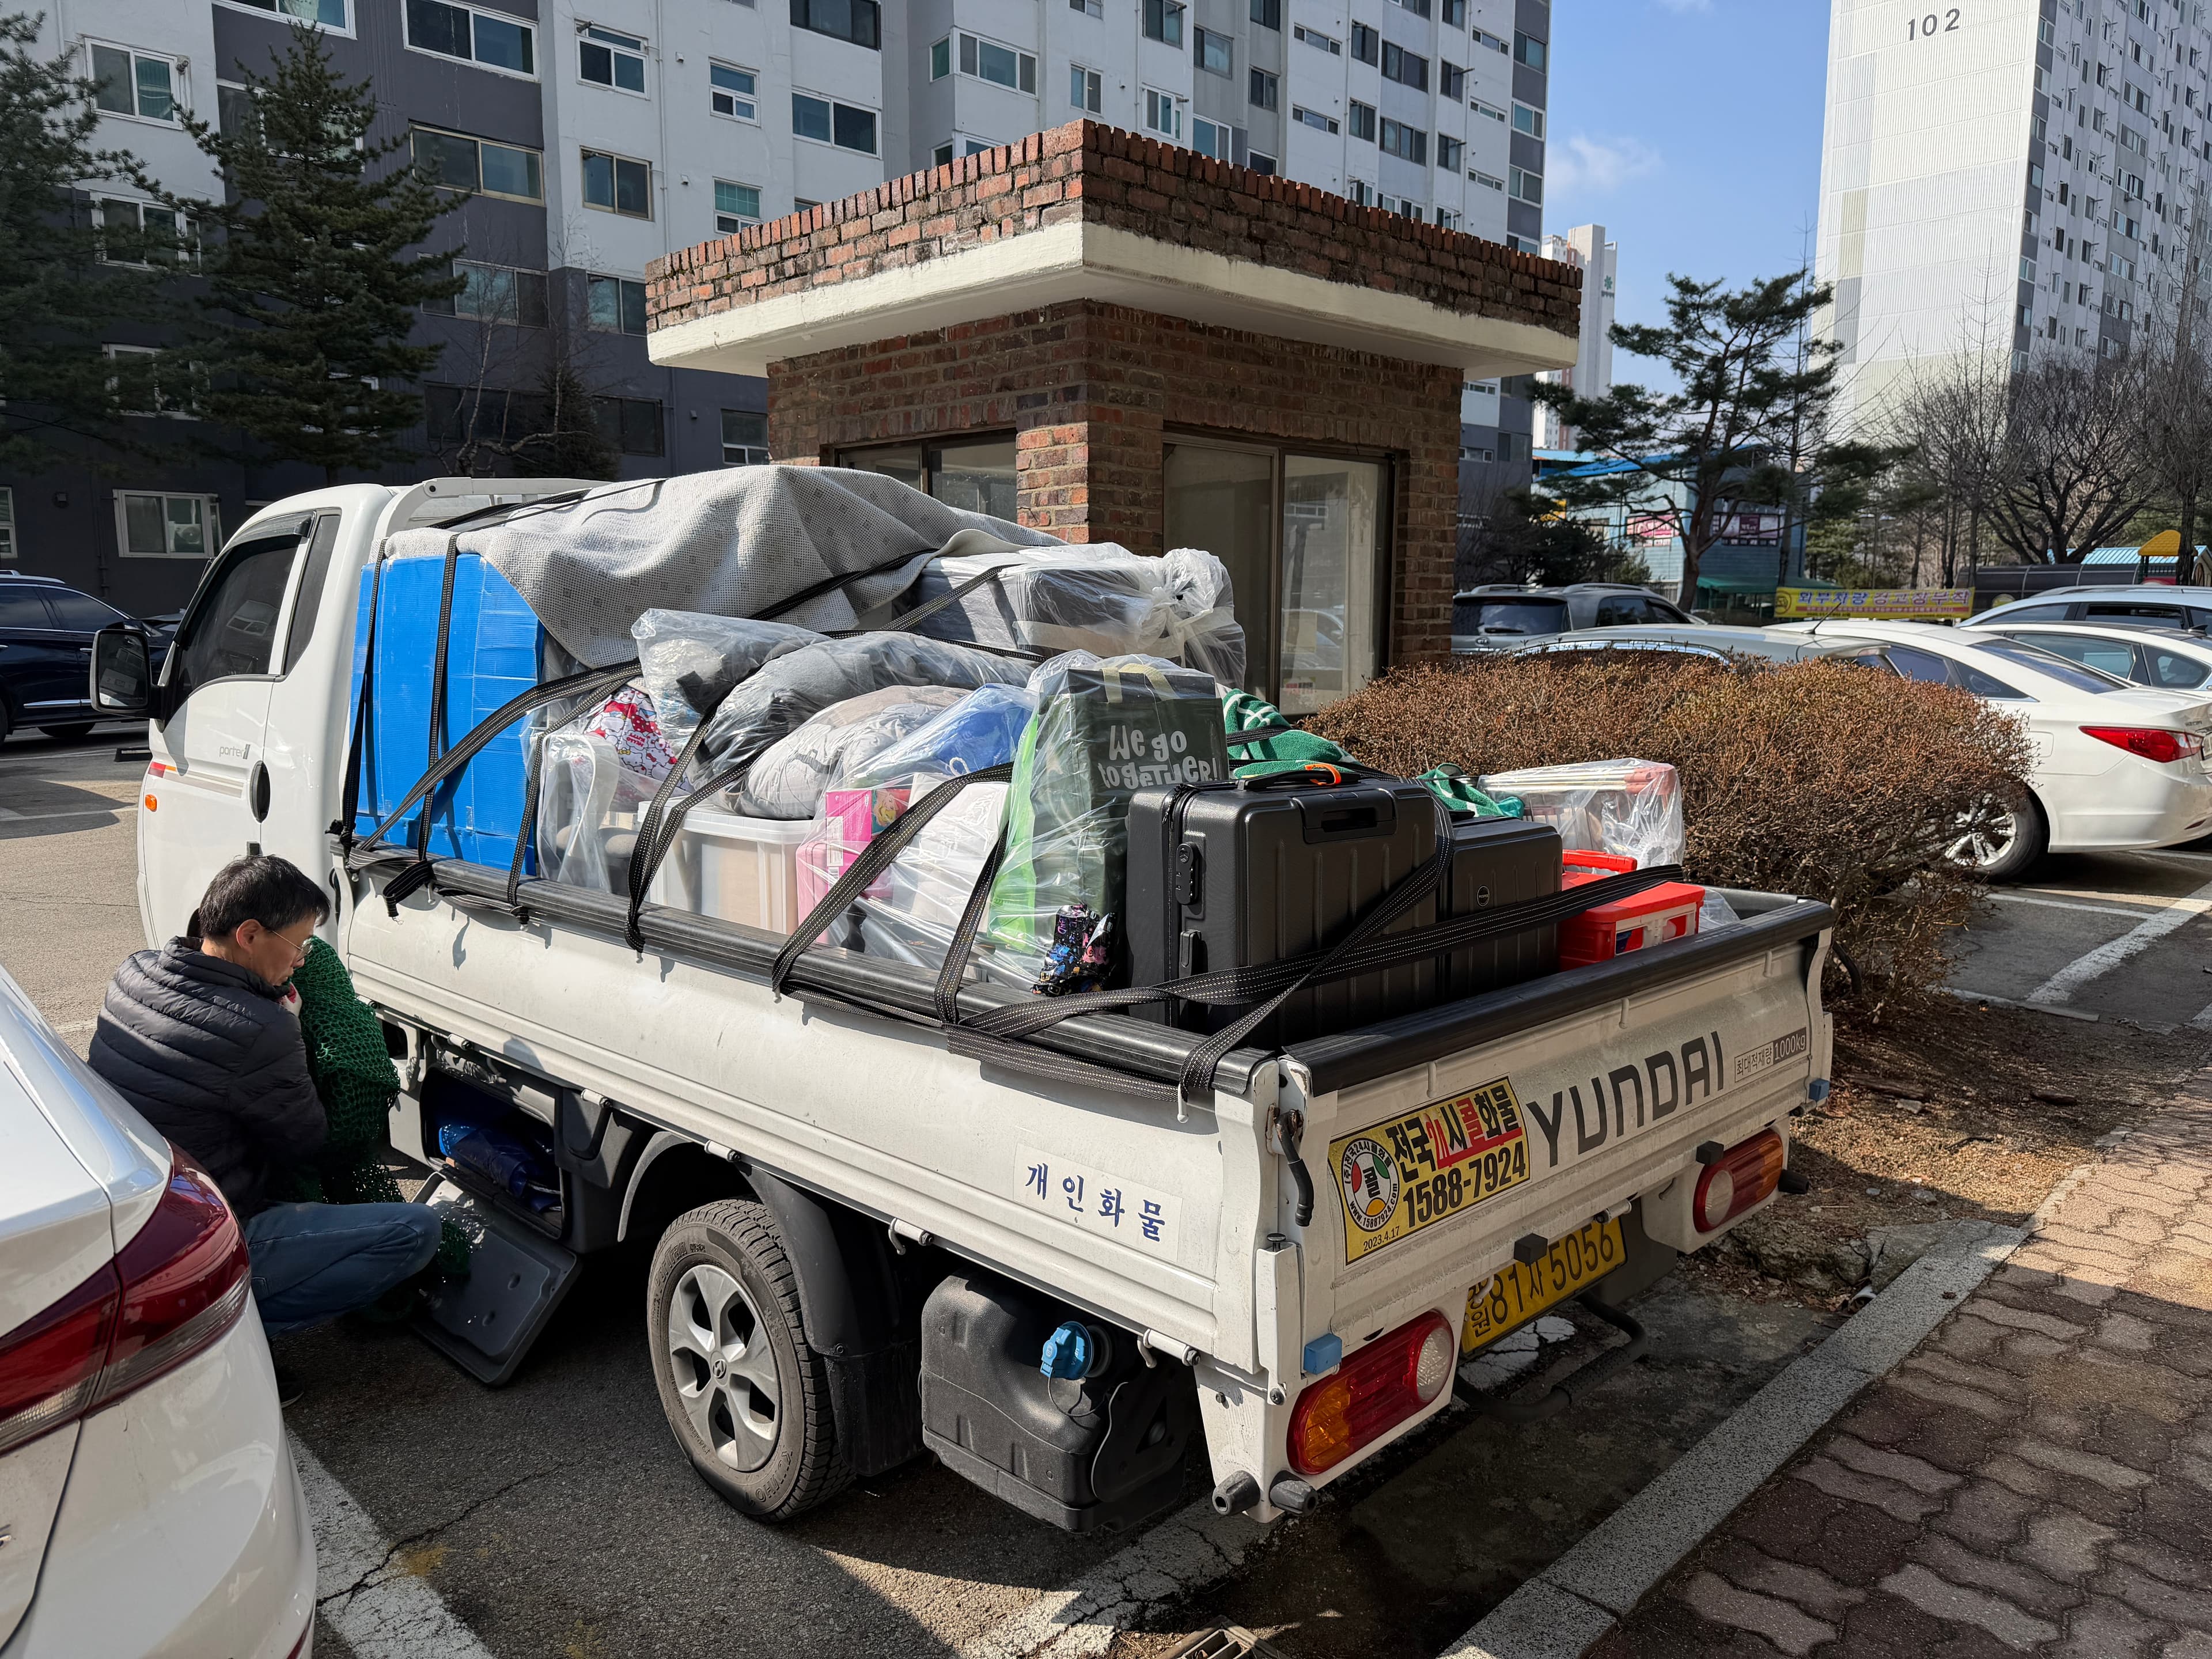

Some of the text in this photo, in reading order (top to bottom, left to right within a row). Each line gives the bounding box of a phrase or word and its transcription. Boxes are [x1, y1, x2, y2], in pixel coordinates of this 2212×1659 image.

[1907, 8, 1960, 41] 102
[1798, 591, 1869, 605] 외부차량
[626, 737, 644, 747] HELLO
[1109, 725, 1187, 762] We go
[1737, 1046, 1772, 1076] 최대적재량
[1774, 1033, 1806, 1061] 1000kg
[1403, 1141, 1527, 1228] 1588-7924
[1349, 1183, 1398, 1229] www.15887924.com
[1363, 1225, 1400, 1252] 2023.4.17
